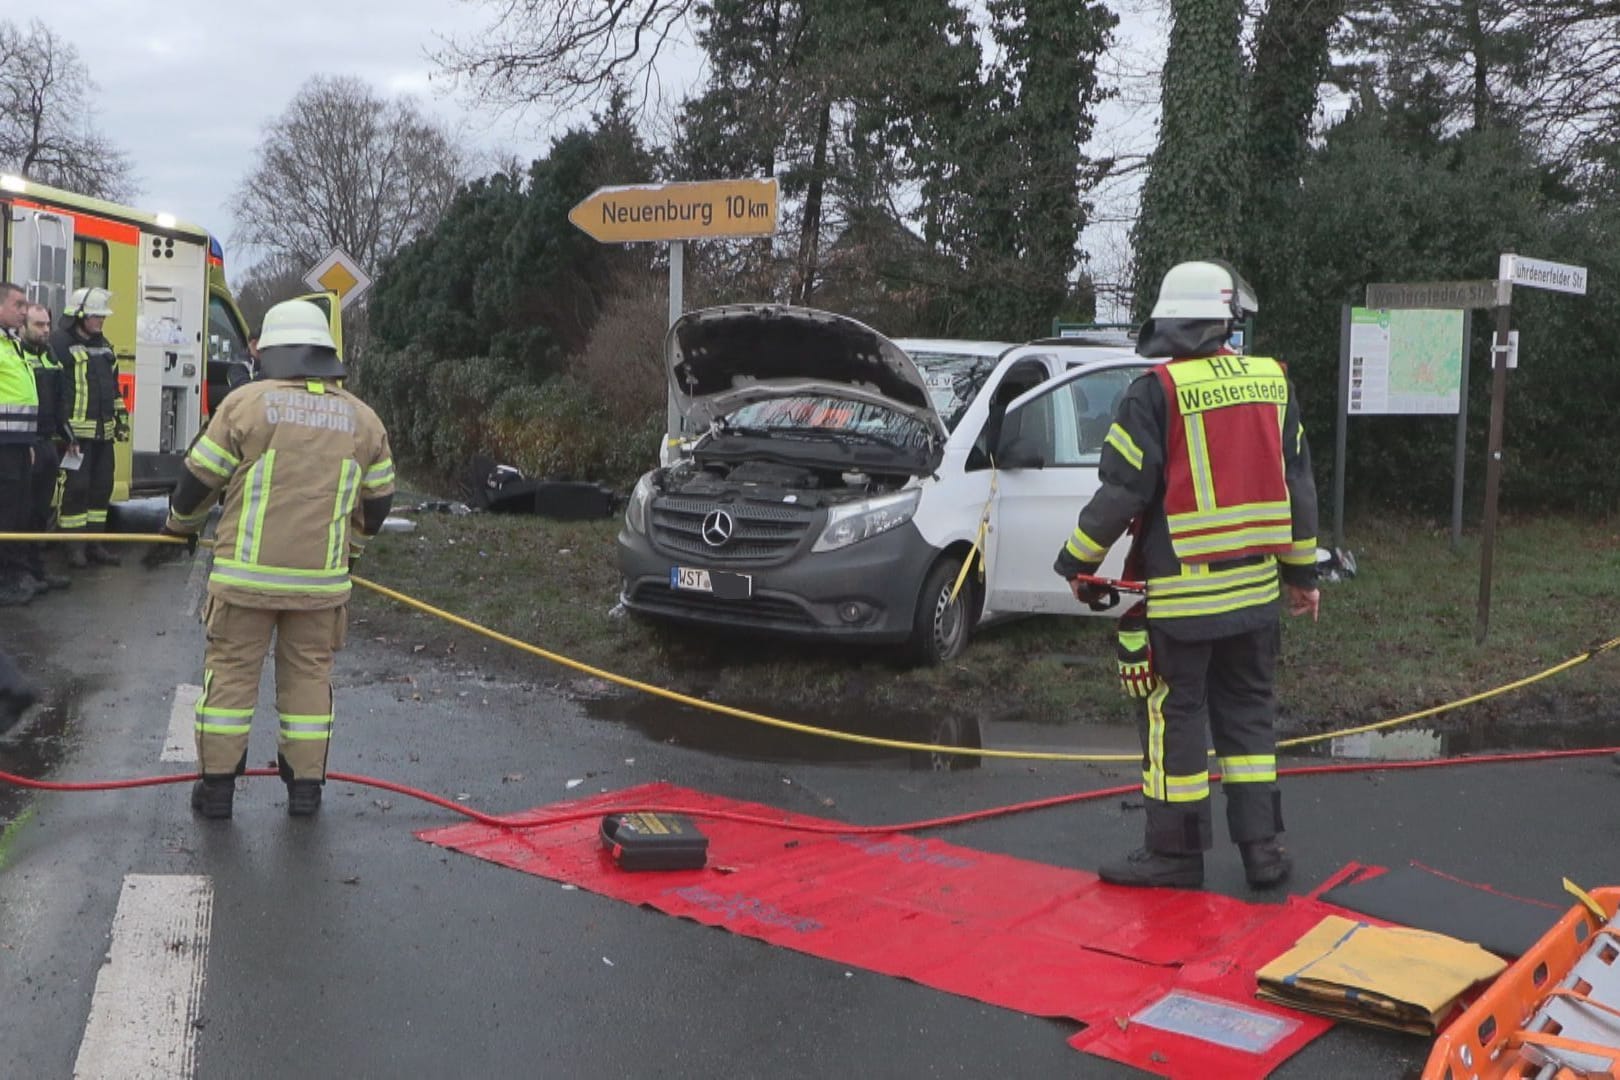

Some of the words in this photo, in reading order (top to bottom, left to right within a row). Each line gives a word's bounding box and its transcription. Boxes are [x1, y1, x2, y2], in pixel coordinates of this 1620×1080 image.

[602, 200, 713, 226] Neuenburg
[725, 195, 745, 218] 10
[749, 199, 769, 218] km
[1208, 357, 1250, 377] HLF
[1181, 380, 1286, 410] Westerstede
[267, 406, 356, 433] ODENBUR
[679, 570, 702, 587] WST
